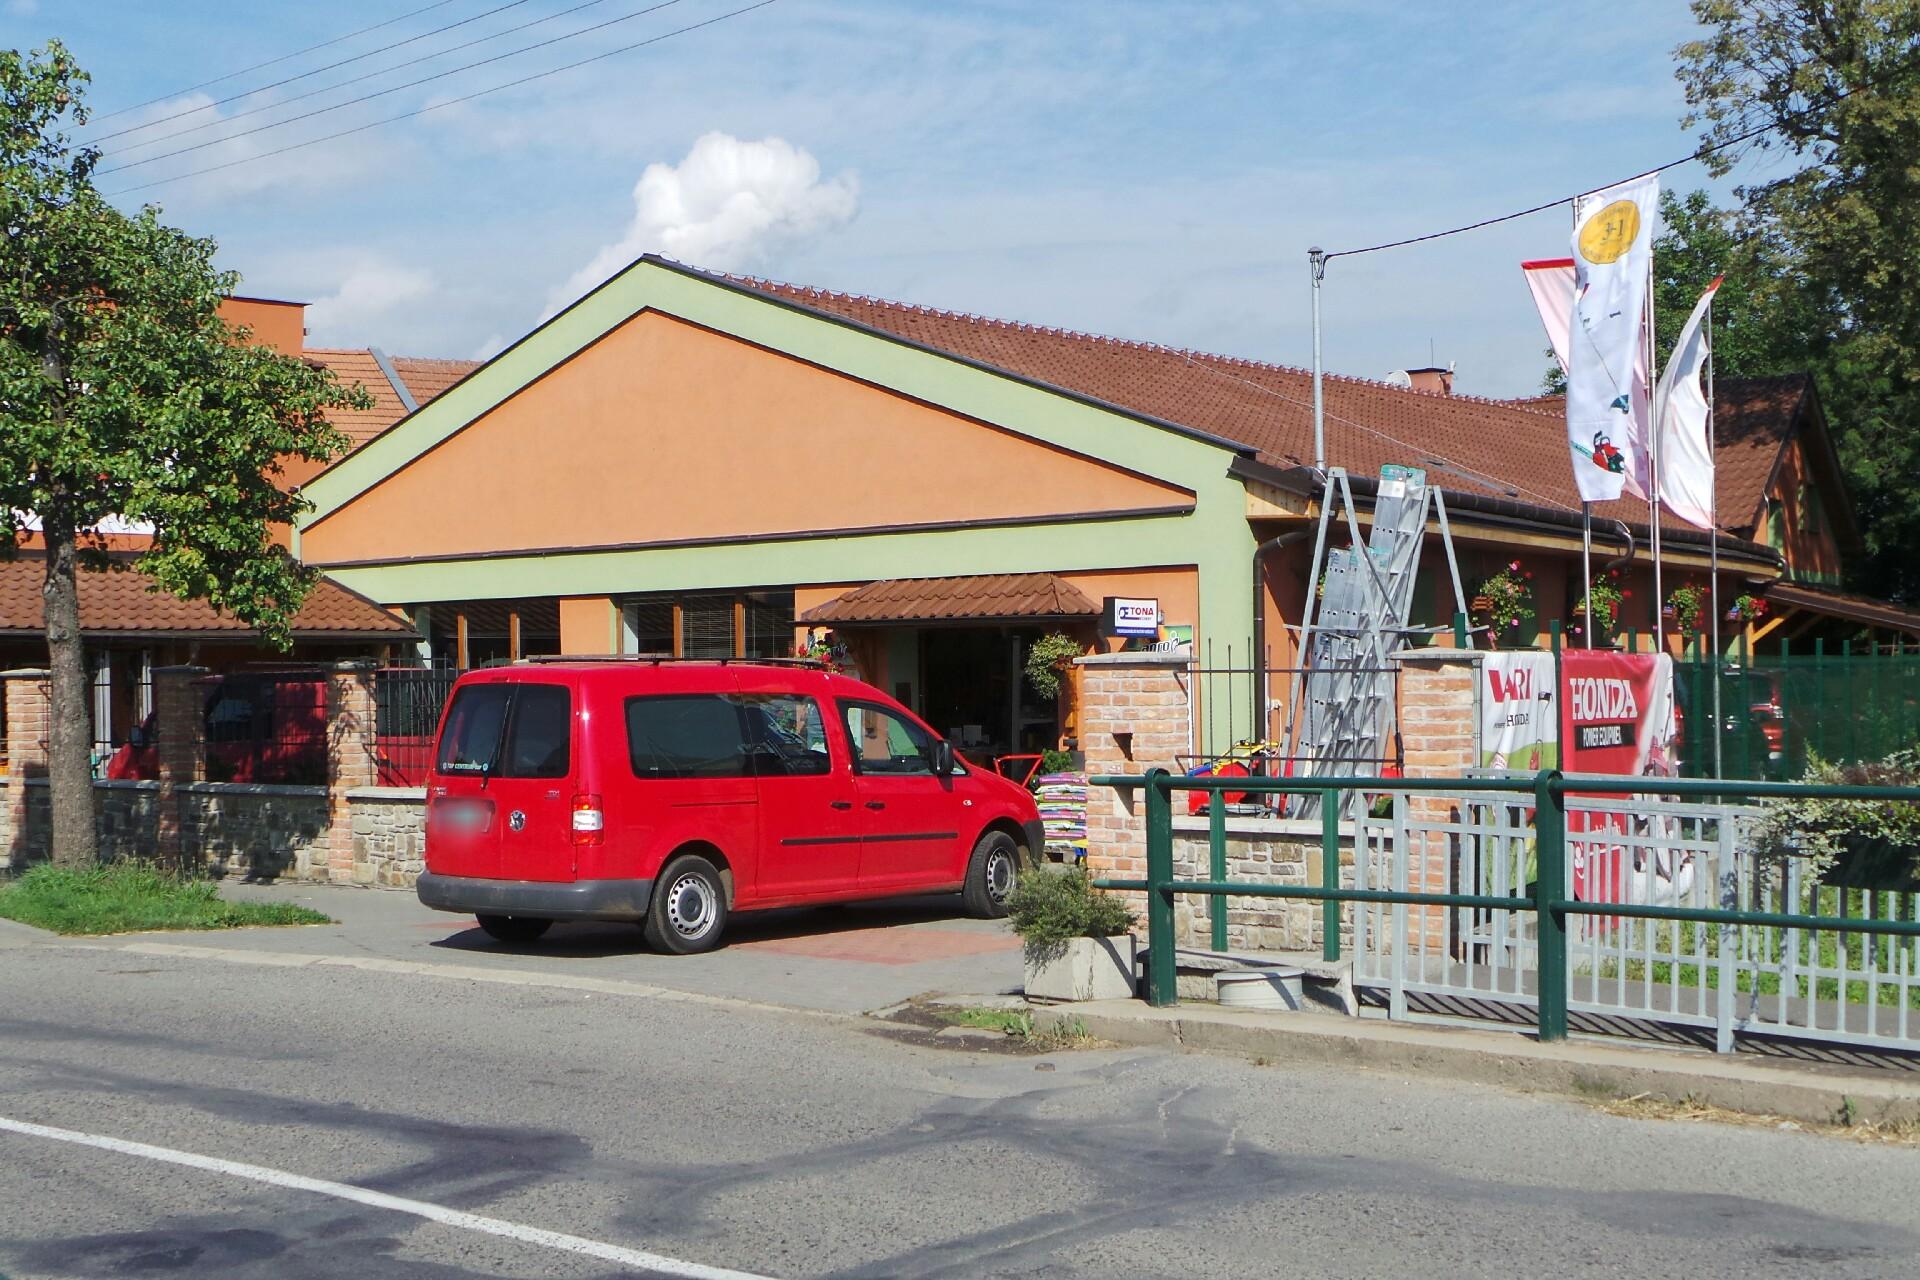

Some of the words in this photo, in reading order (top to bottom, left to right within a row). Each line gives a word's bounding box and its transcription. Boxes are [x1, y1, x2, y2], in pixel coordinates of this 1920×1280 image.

[1130, 607, 1154, 616] TONA
[1488, 668, 1531, 704] VARI
[1569, 677, 1638, 720] HONDA
